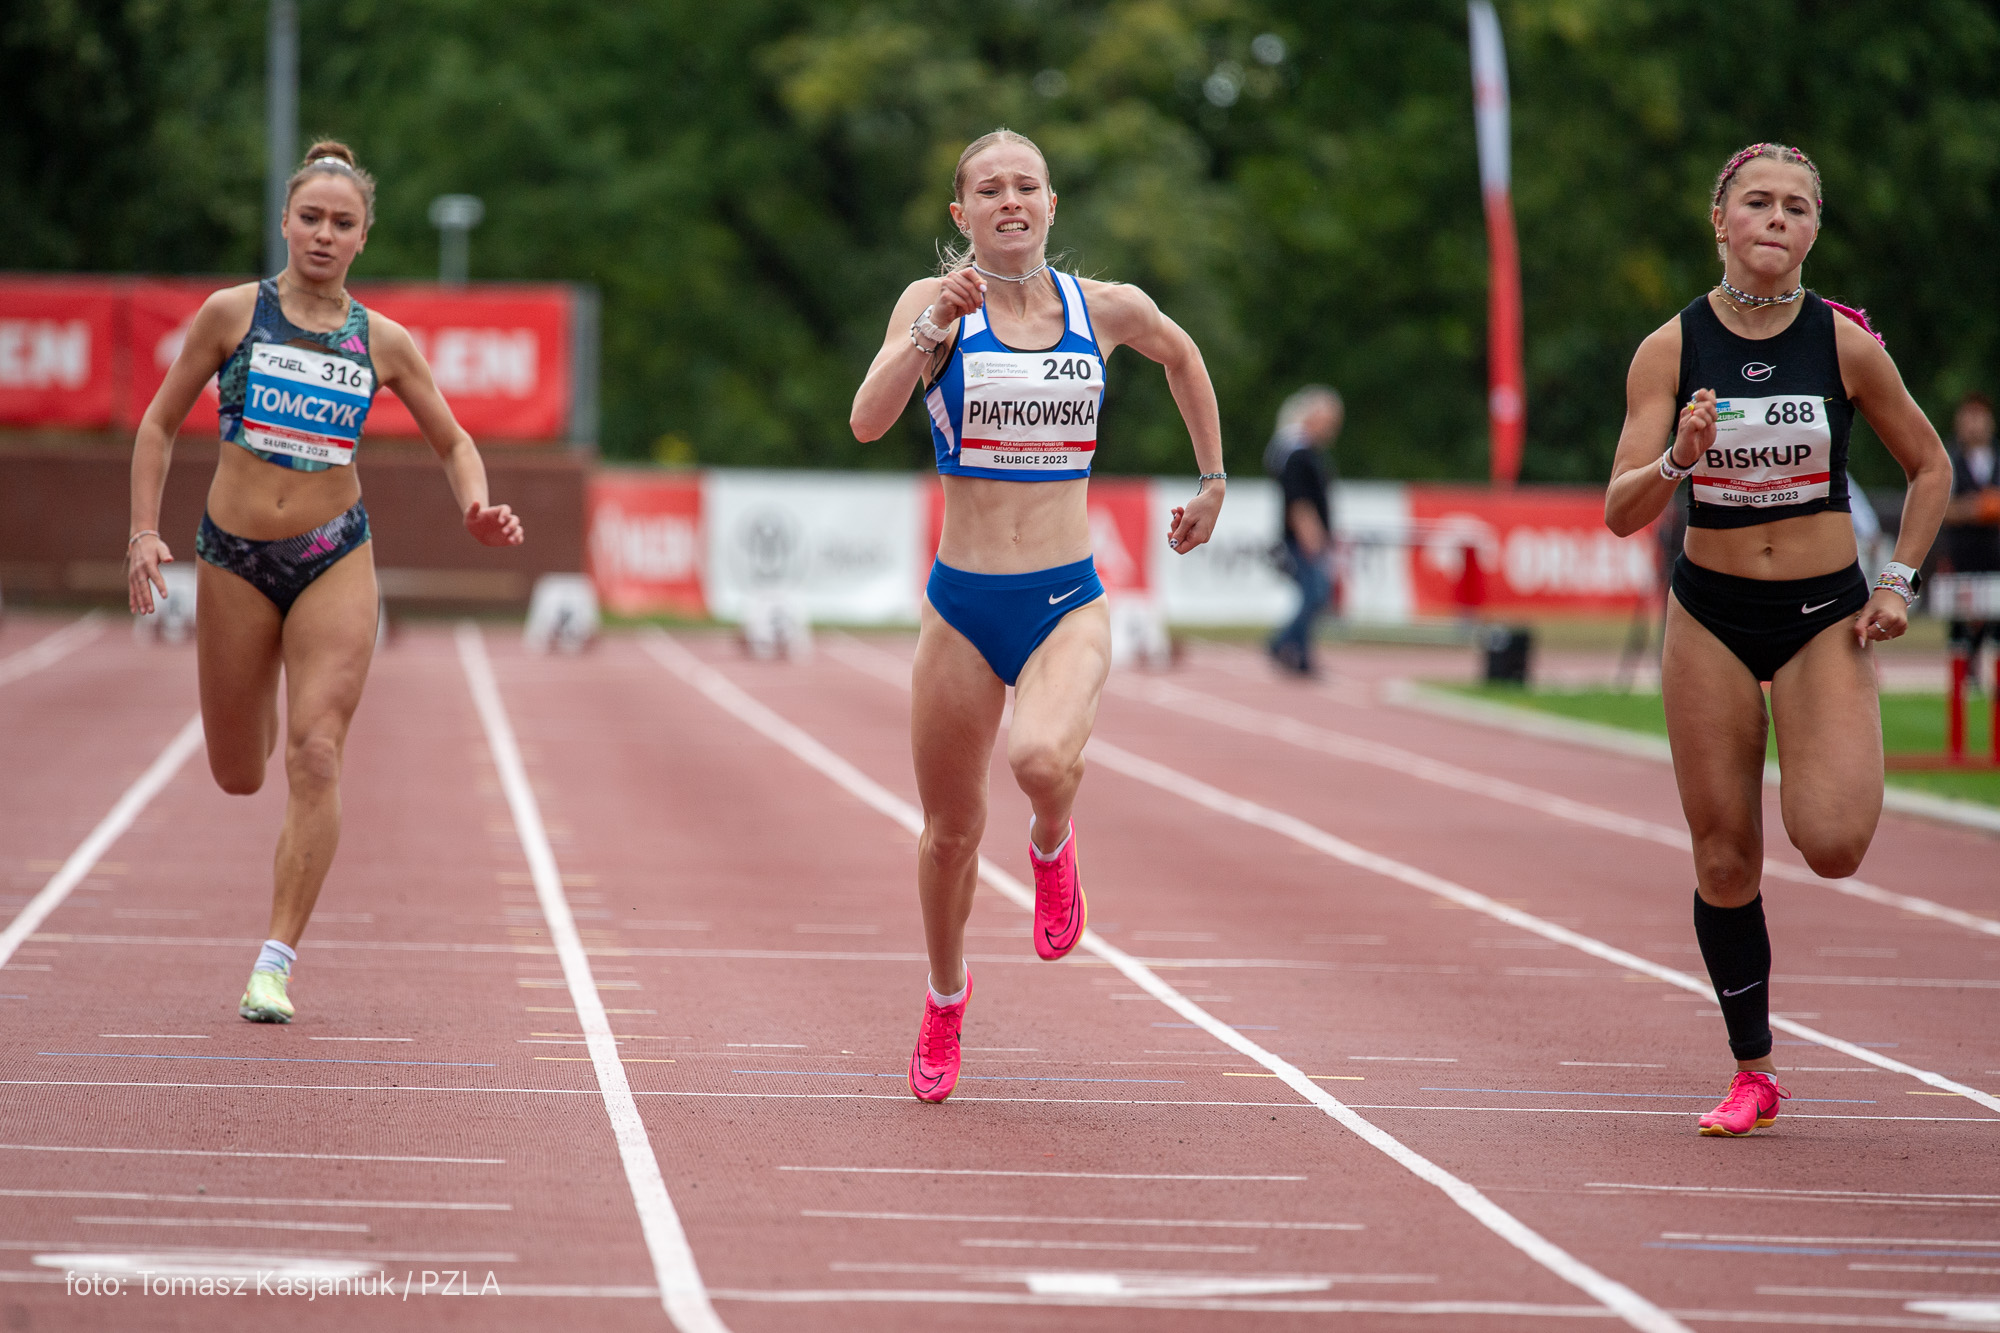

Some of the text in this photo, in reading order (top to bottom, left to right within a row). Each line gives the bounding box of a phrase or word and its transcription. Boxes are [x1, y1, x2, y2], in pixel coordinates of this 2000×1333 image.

[268, 356, 306, 373] FUEL
[321, 362, 362, 388] 316
[1042, 358, 1091, 380] 240
[251, 383, 361, 428] TOMCZYK
[968, 400, 1095, 430] PIĄTKOWSKA
[1765, 401, 1815, 426] 688
[263, 437, 329, 458] SŁUBICE 2023
[993, 454, 1068, 464] SŁUBICE 2023
[1705, 444, 1812, 469] BISKUP
[1722, 490, 1799, 504] SŁUBICE 2023
